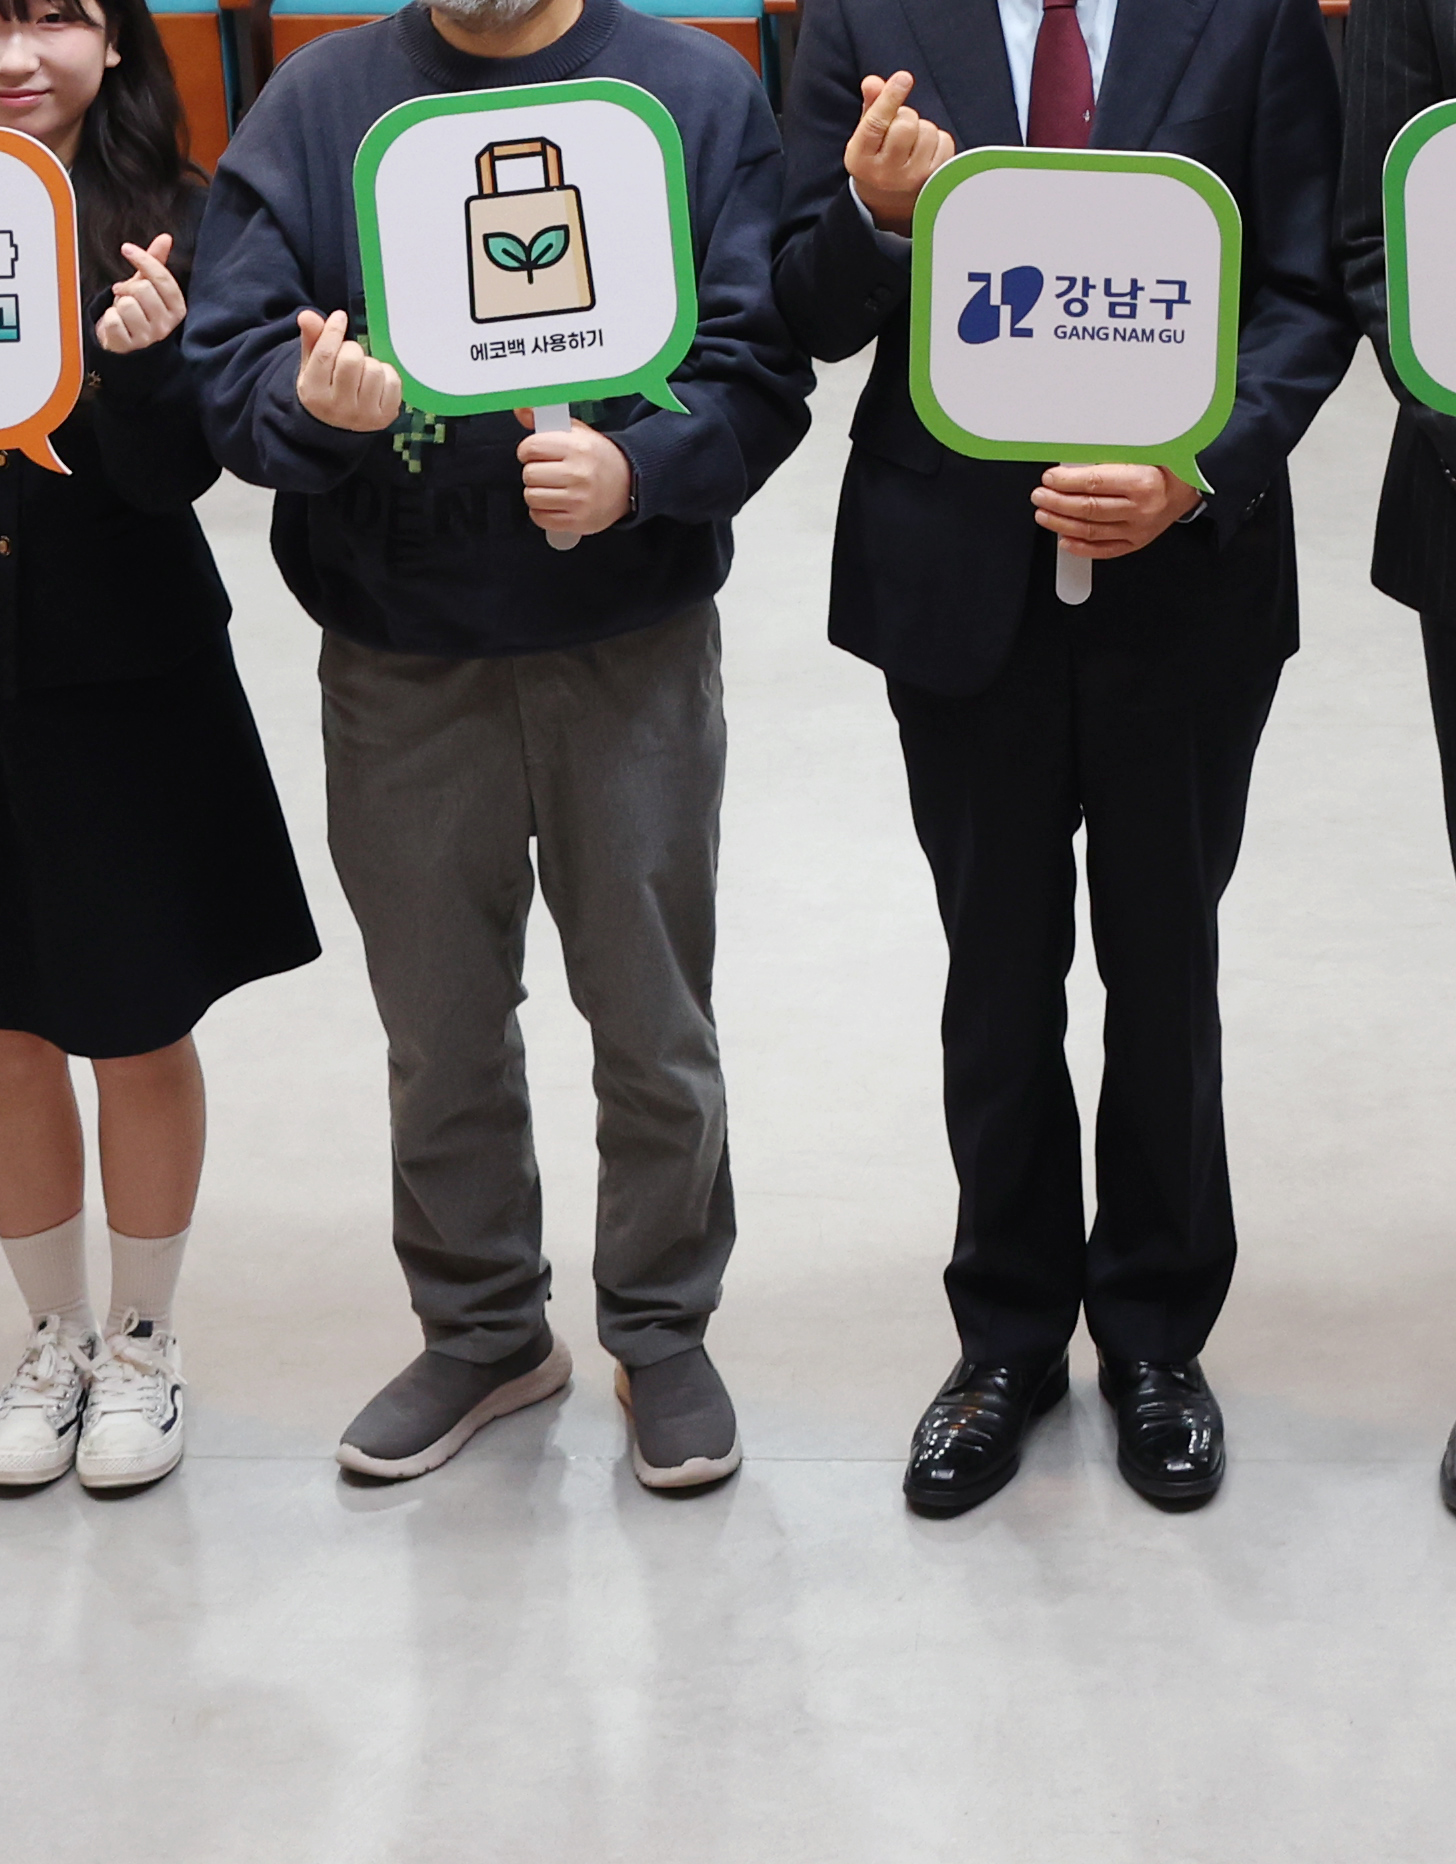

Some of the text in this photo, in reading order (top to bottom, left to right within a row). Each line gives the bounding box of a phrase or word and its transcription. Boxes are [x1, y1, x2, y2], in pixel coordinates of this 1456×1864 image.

[1054, 275, 1192, 320] 강남구
[469, 329, 604, 362] 에코백 사용하기
[1054, 325, 1185, 344] GANG NAM GU
